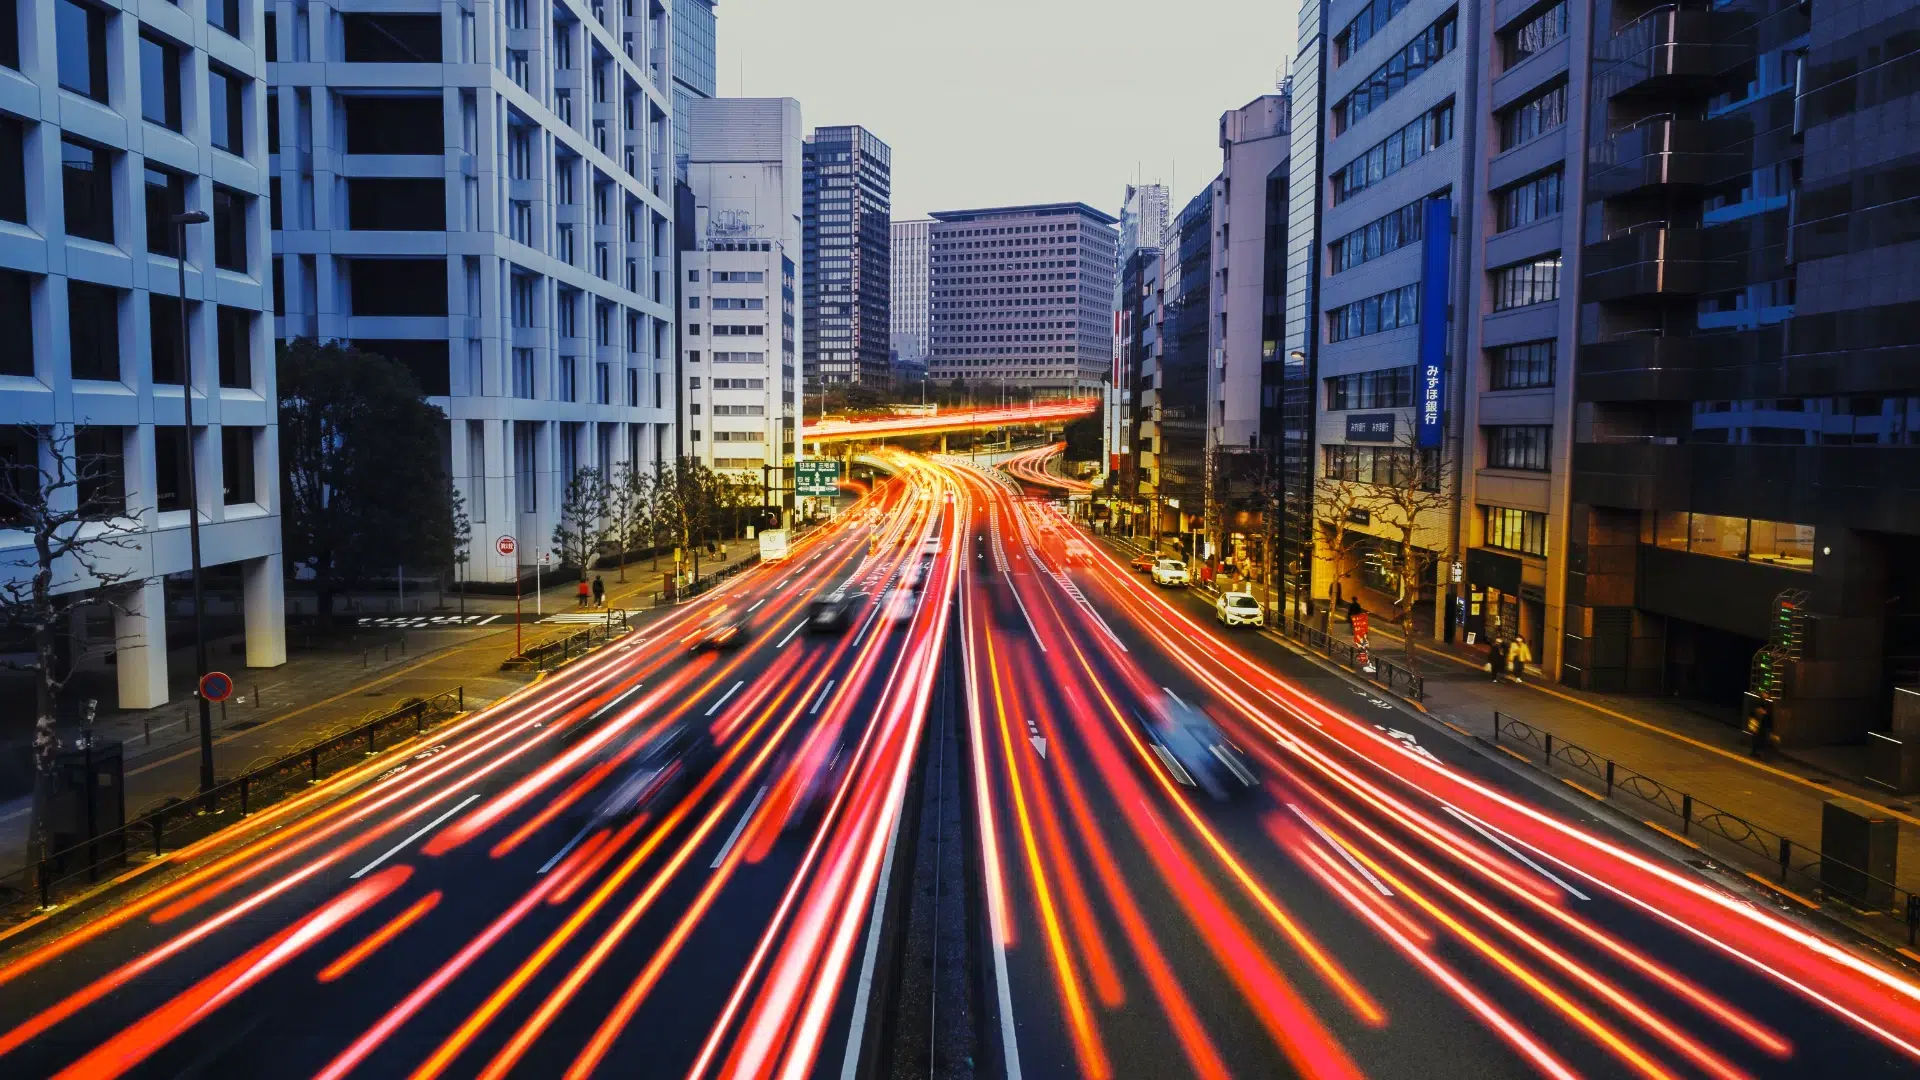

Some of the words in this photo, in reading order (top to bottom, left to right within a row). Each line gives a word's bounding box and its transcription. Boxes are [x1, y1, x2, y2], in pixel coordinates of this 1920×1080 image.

[1425, 366, 1438, 424] みずほ銀行
